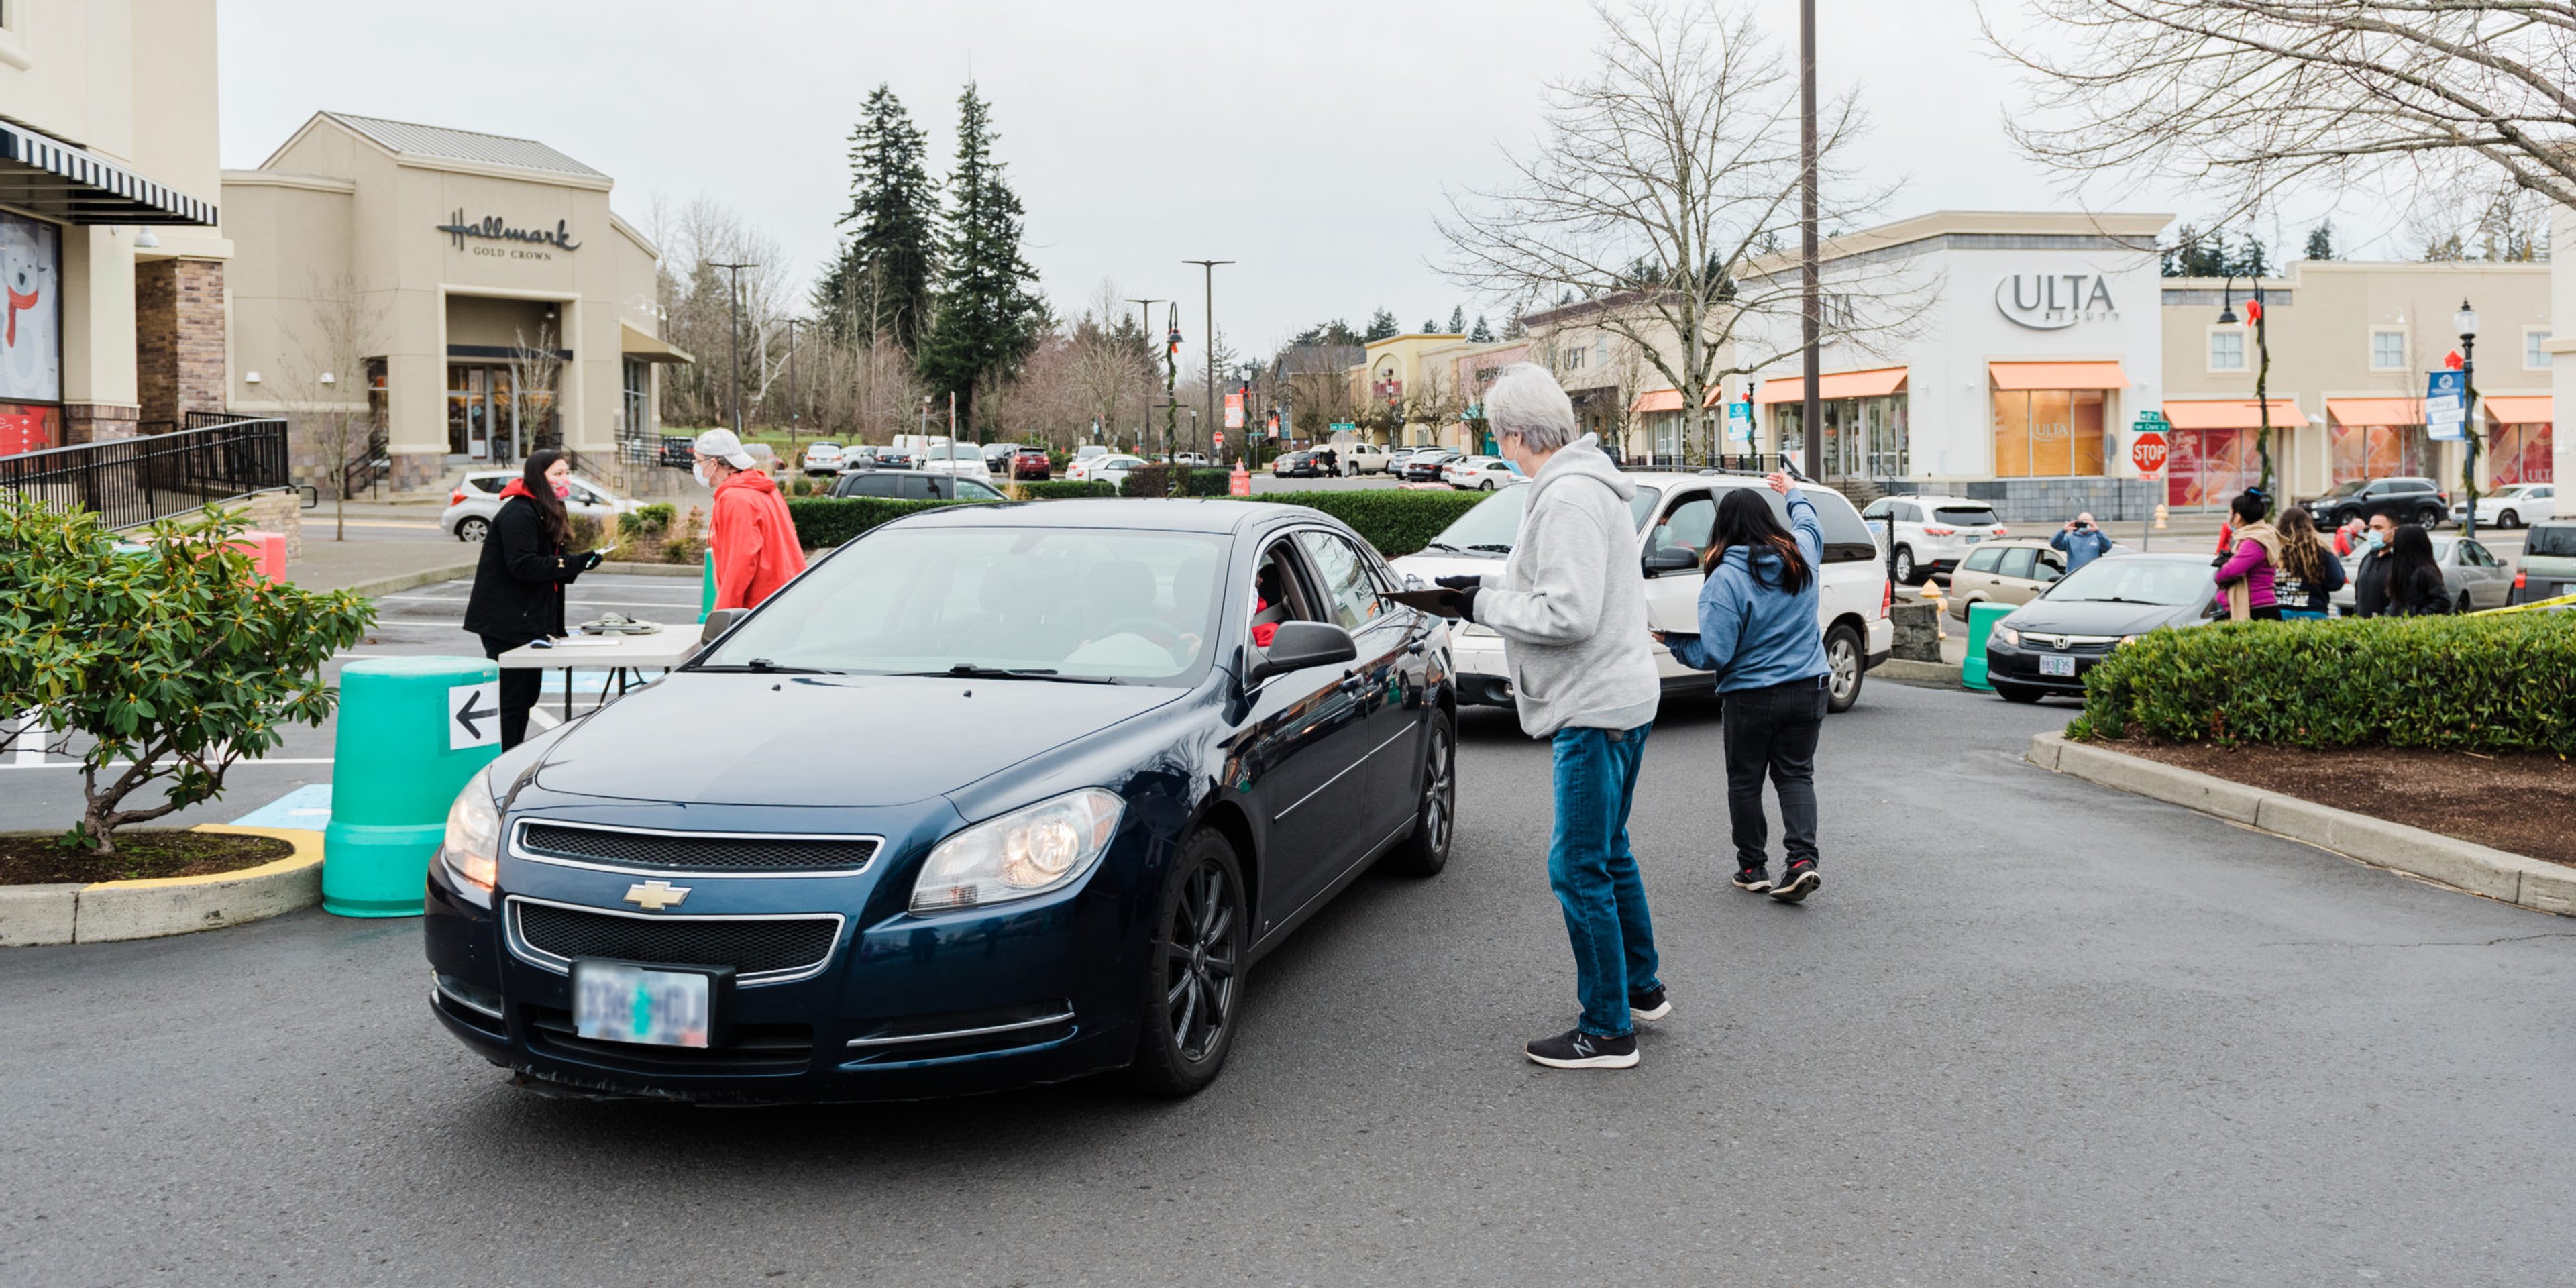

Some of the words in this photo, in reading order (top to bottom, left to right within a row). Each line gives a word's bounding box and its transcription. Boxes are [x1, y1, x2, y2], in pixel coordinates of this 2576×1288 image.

[436, 207, 582, 252] Hallmark
[474, 246, 504, 257] GOLD
[511, 250, 551, 260] CROWN
[2013, 274, 2115, 311] ULTA
[2134, 445, 2165, 461] STOP
